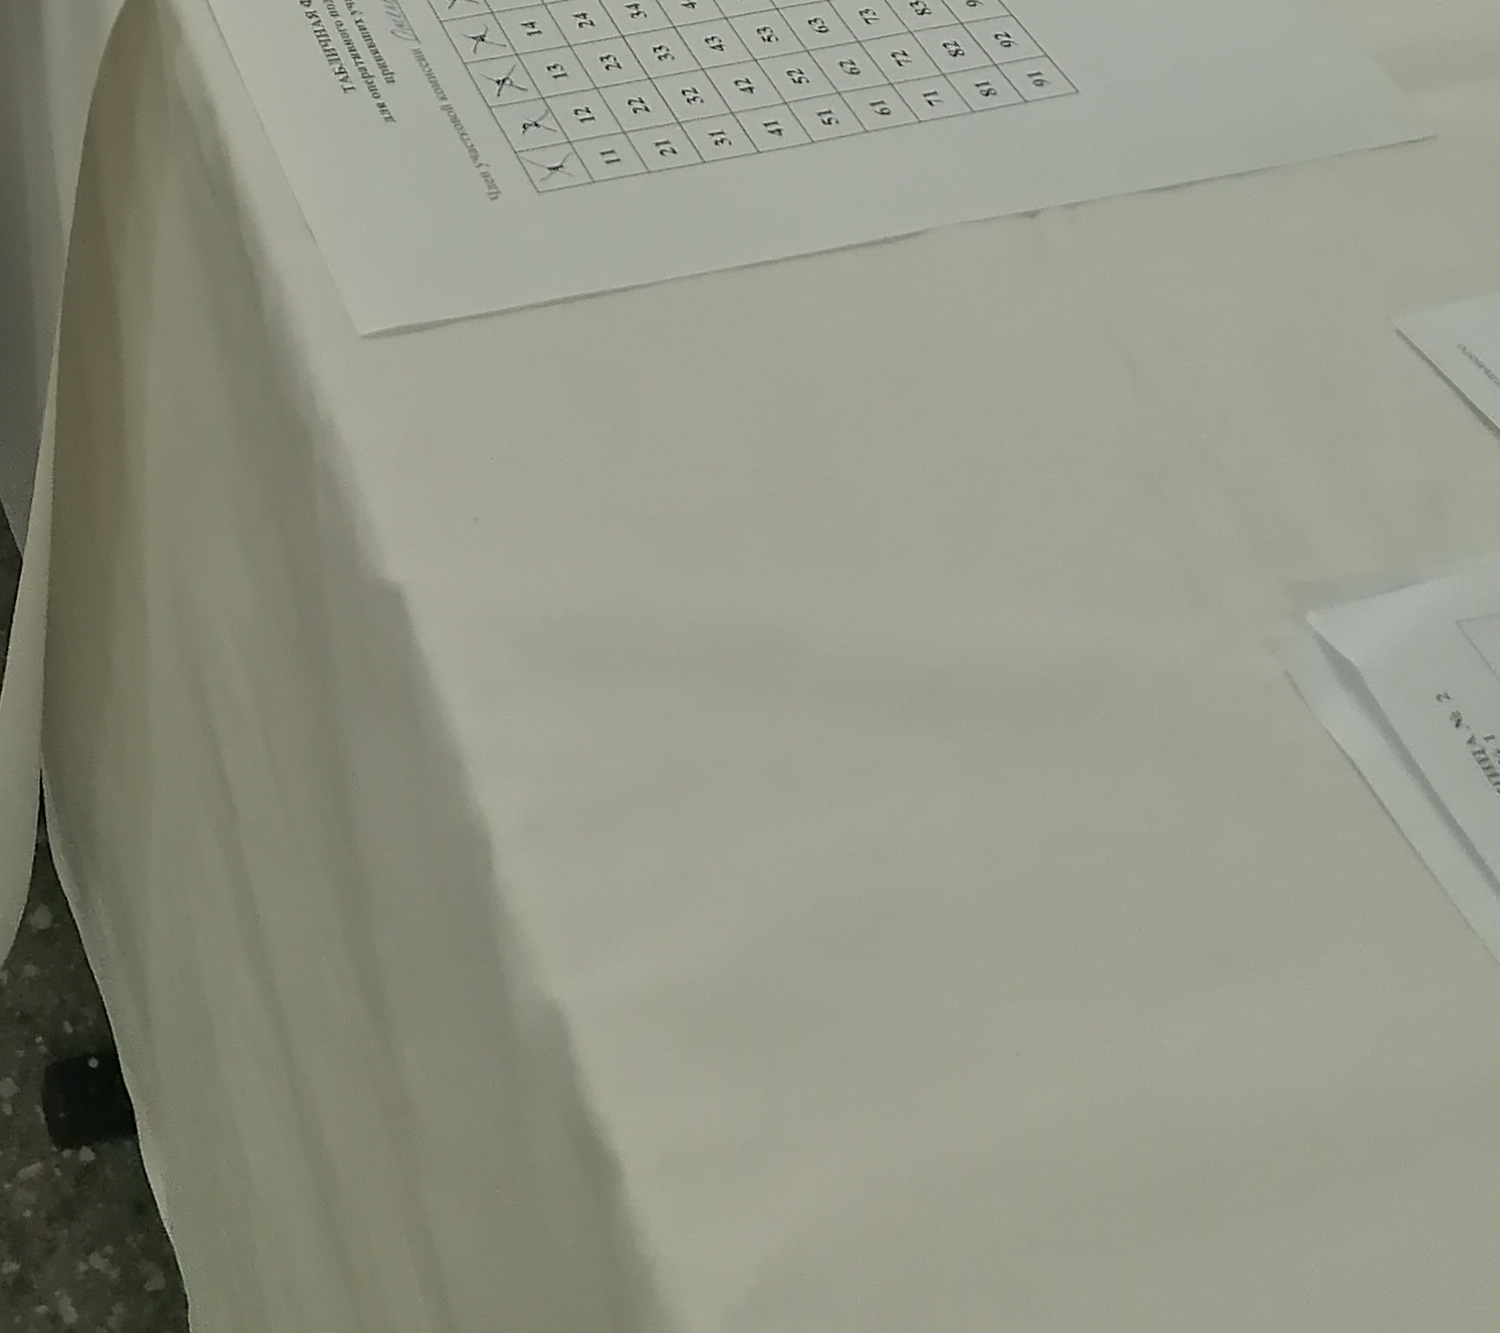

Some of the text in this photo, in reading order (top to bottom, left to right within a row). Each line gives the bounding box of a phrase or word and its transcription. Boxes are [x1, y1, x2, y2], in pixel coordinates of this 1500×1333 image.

[624, 2, 647, 18] 34
[908, 0, 932, 16] 83
[572, 12, 595, 28] 24
[858, 8, 878, 25] 73
[520, 21, 542, 36] 14
[807, 17, 829, 33] 63
[755, 26, 779, 42] 53
[993, 31, 1015, 48] 92
[304, 9, 356, 93] ТАБЛИЧНАЯ
[353, 17, 396, 84] принявших
[704, 35, 724, 51] 43
[941, 40, 965, 57] 82
[334, 19, 381, 99] оперативного
[652, 44, 675, 61] 33
[890, 49, 911, 66] 72
[598, 54, 622, 71] 23
[838, 59, 861, 75] 62
[545, 63, 568, 79] 13
[785, 68, 810, 84] 52
[1026, 70, 1047, 87] 91
[733, 77, 754, 94] 42
[973, 81, 997, 97] 81
[680, 87, 704, 104] 32
[922, 90, 941, 107] 71
[375, 101, 396, 122] для
[626, 96, 650, 114] 22
[868, 100, 891, 115] 61
[573, 106, 595, 123] 12
[816, 109, 839, 125] 51
[411, 47, 502, 201] Член участковой комиссии
[762, 120, 782, 136] 41
[708, 130, 732, 146] 31
[654, 140, 677, 156] 21
[599, 149, 621, 164] 11
